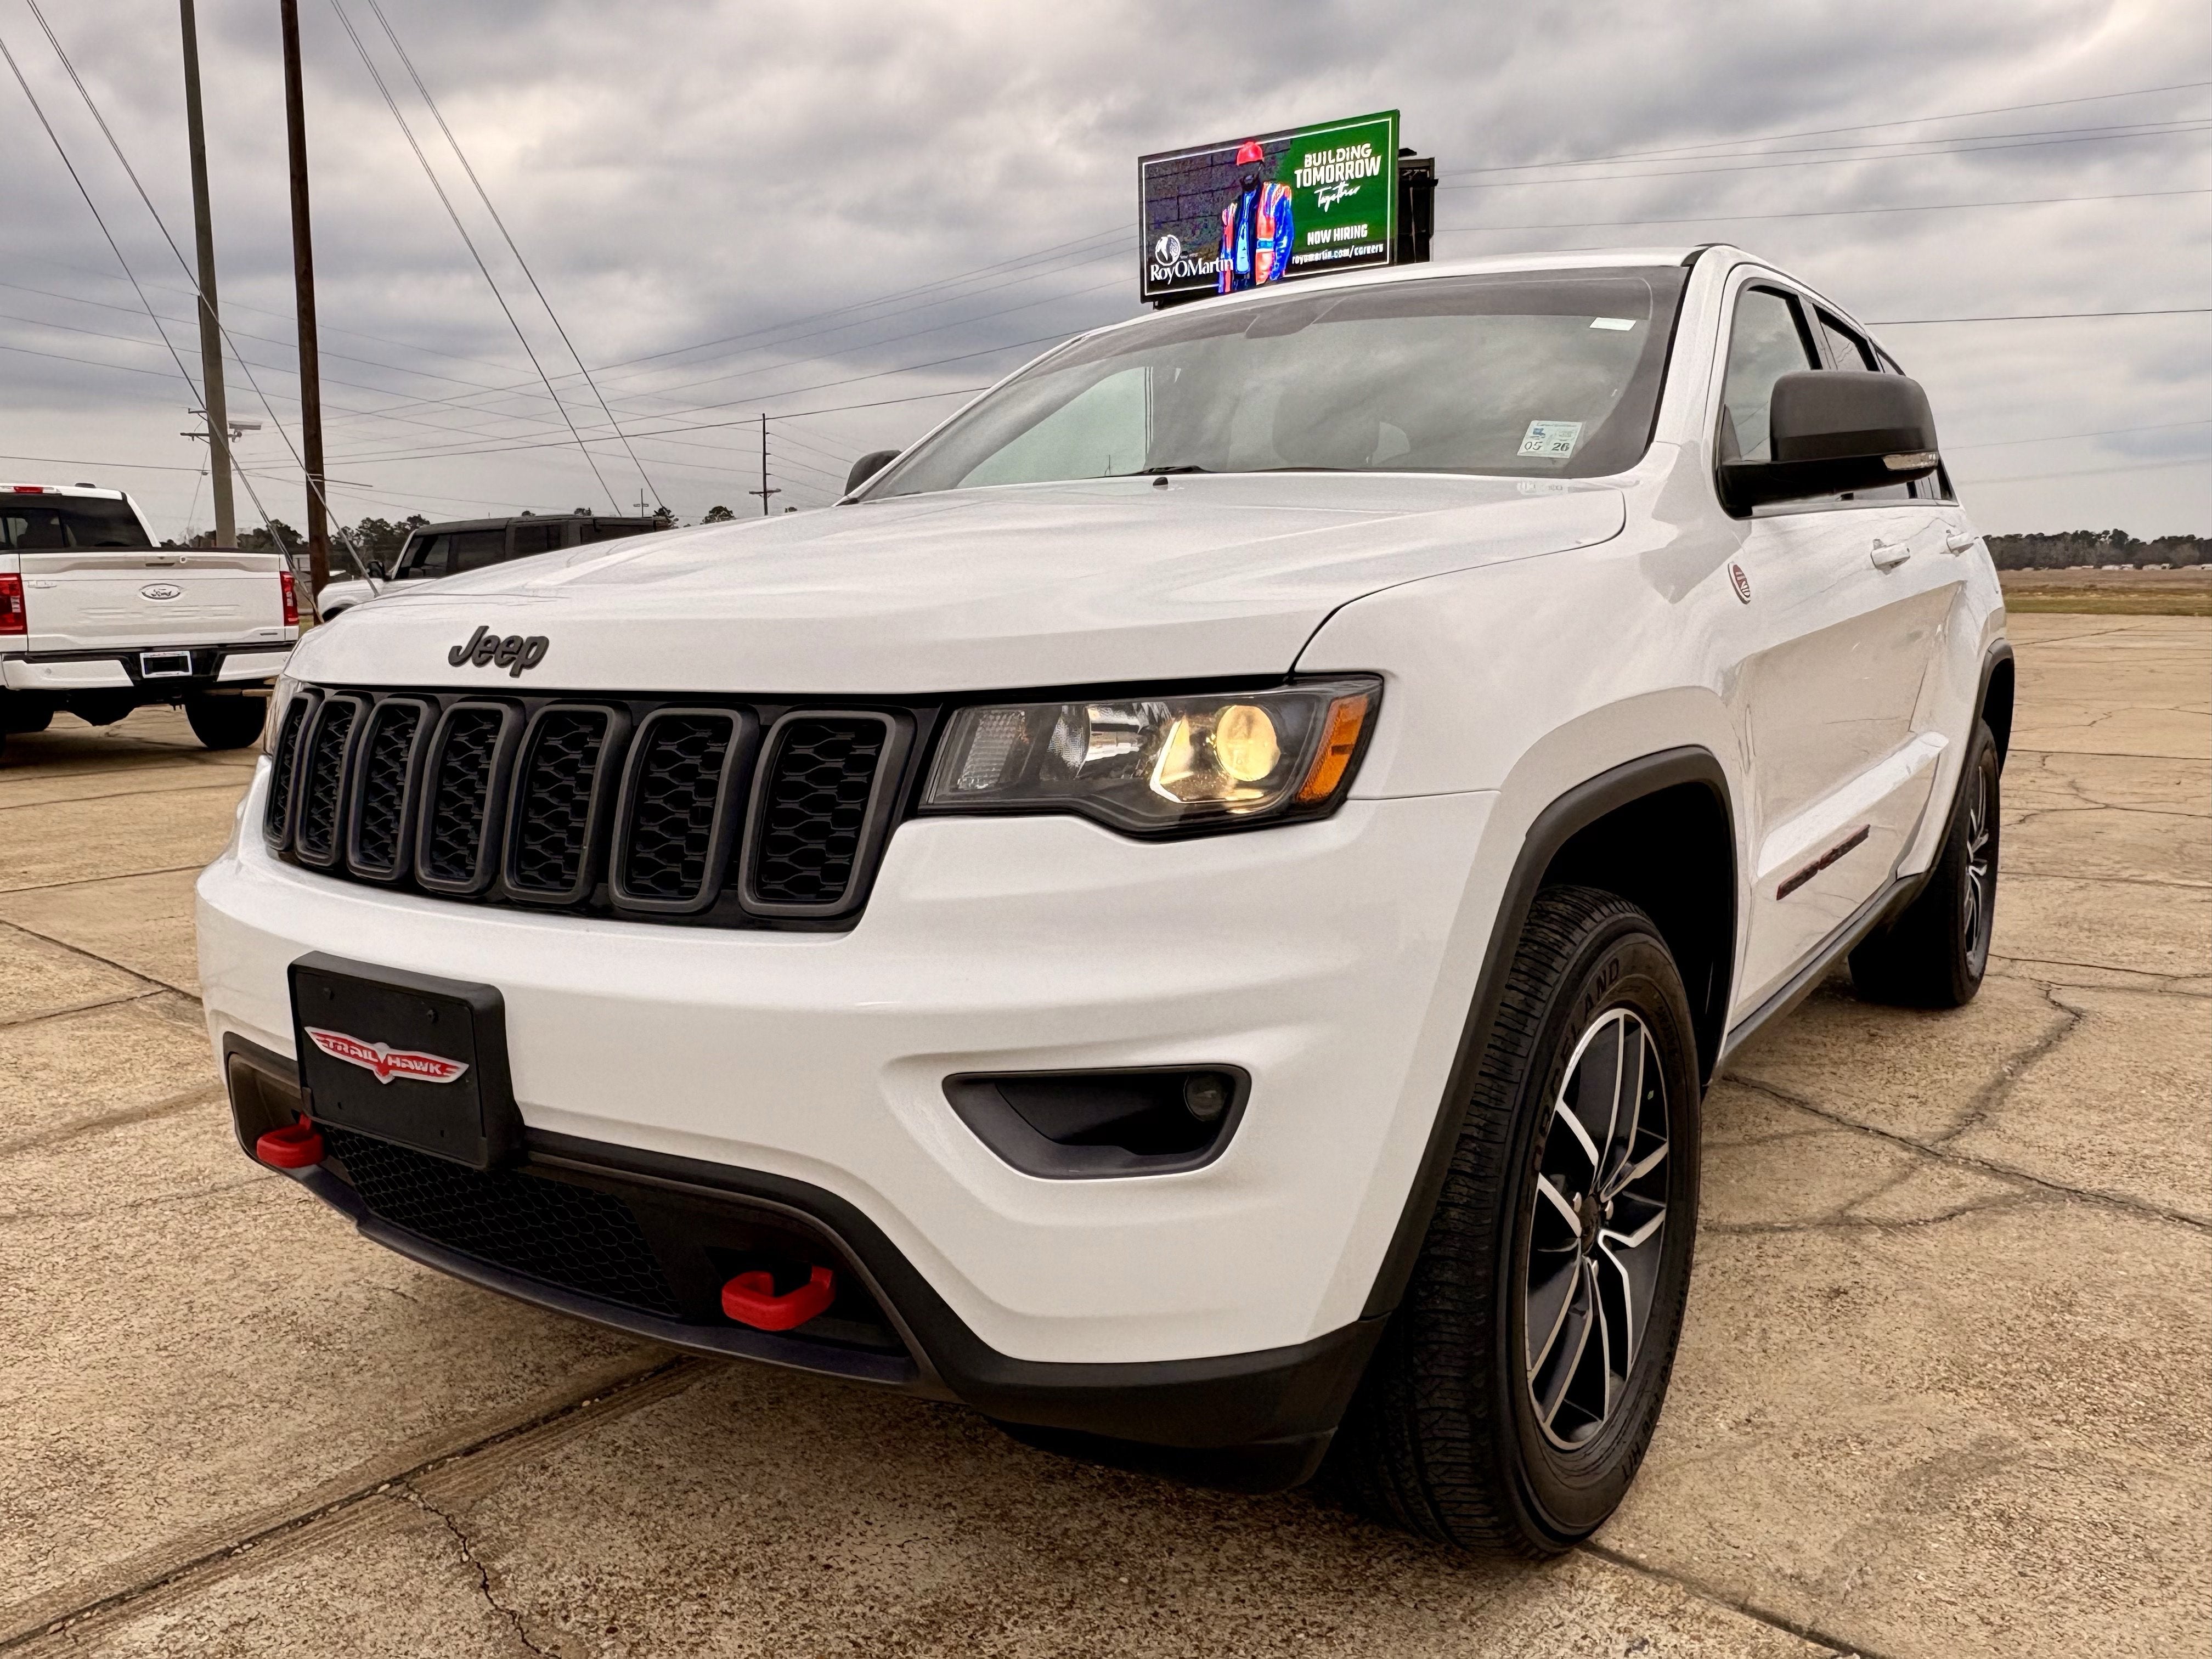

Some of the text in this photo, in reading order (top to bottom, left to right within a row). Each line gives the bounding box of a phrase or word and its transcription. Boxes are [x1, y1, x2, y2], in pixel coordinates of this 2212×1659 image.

[1304, 143, 1372, 168] BUILDING
[1294, 155, 1382, 189] TOMORROW
[1307, 224, 1368, 246] NOW HIRING
[1150, 257, 1234, 285] RoyOMartin
[1525, 441, 1570, 452] 05 26
[448, 625, 550, 679] Jeep
[325, 1038, 443, 1075] TRAIL HAWK
